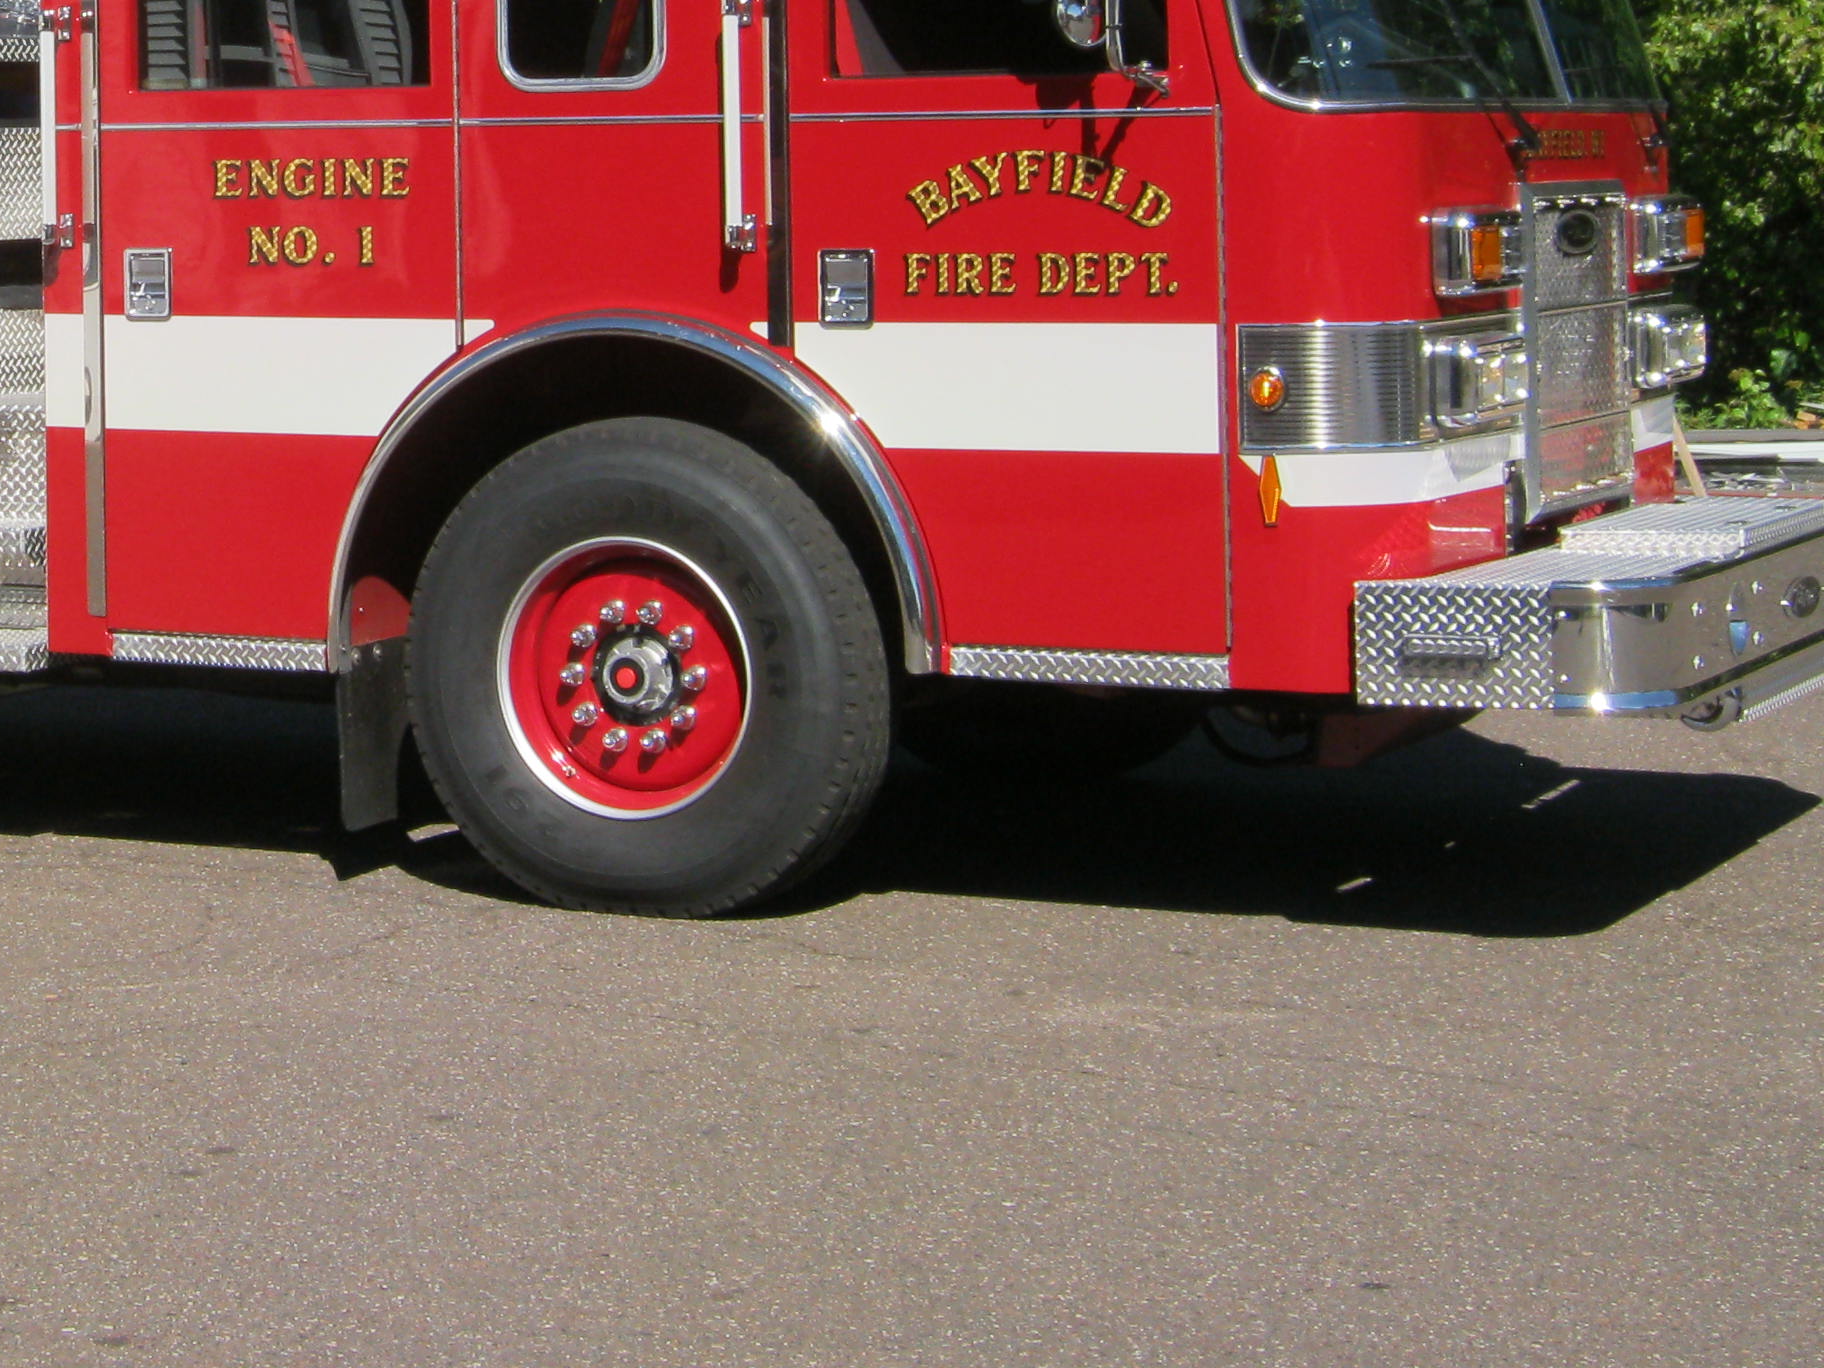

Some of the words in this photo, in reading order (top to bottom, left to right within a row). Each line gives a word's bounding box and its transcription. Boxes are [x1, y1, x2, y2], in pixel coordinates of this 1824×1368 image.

[213, 157, 410, 199] ENGINE
[906, 149, 1172, 229] BAYFIELD
[248, 226, 336, 267] NO.
[359, 226, 375, 267] 1
[904, 252, 1017, 297] FIRE
[1038, 252, 1179, 297] DEPT.
